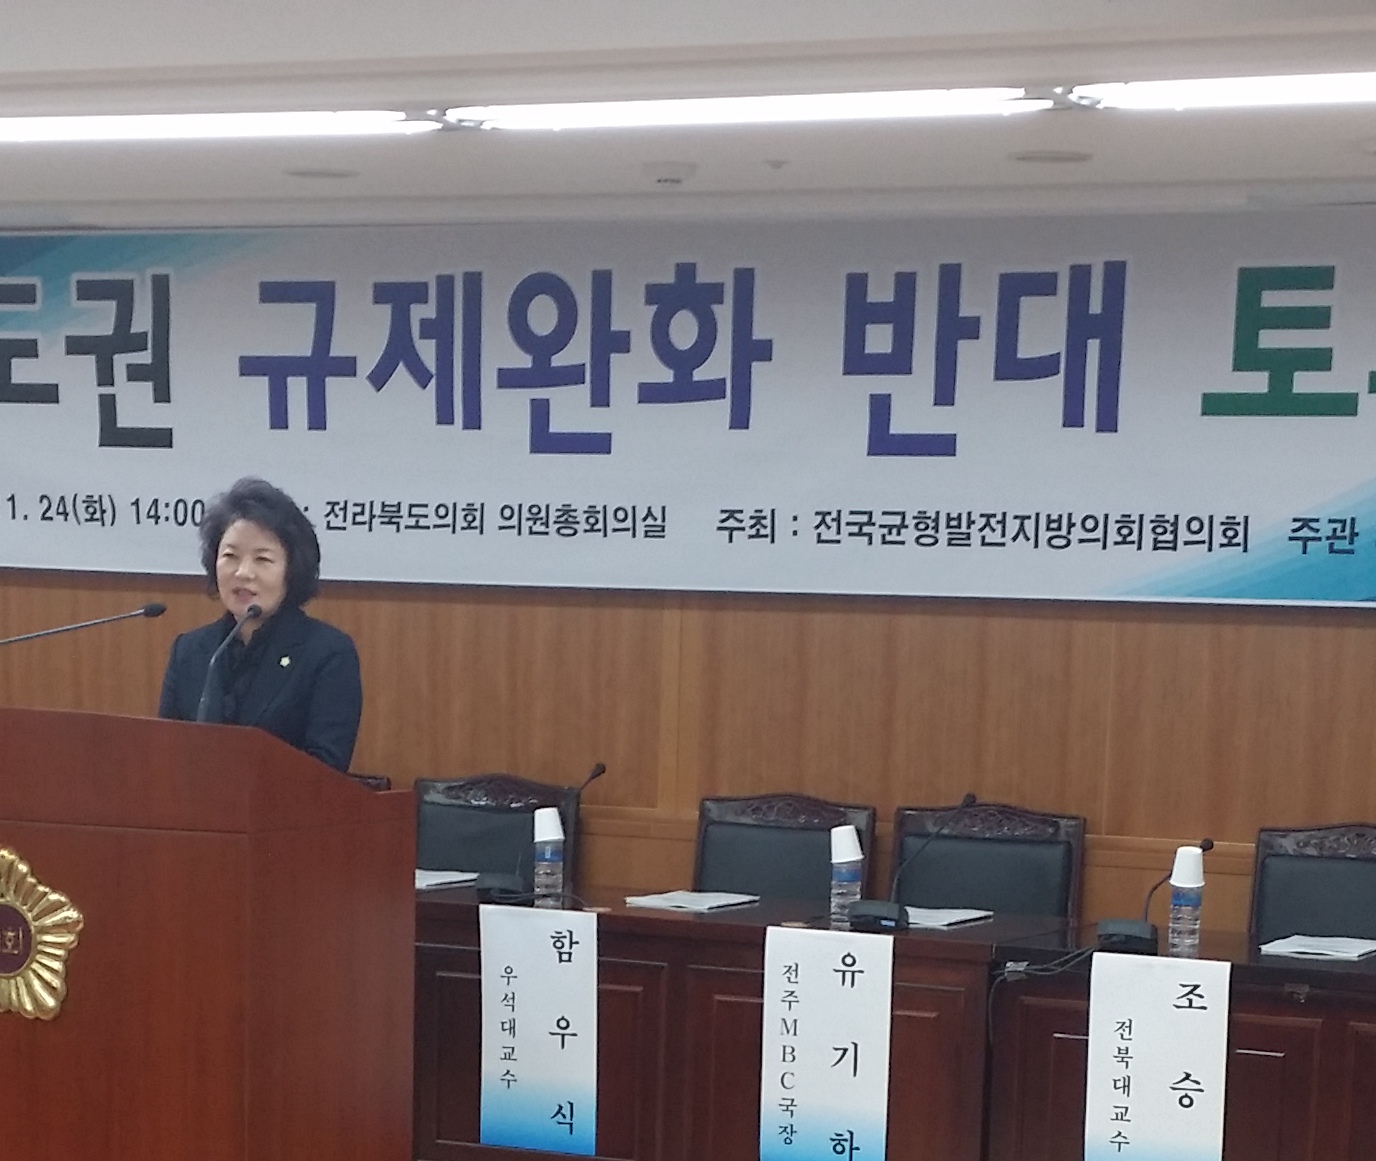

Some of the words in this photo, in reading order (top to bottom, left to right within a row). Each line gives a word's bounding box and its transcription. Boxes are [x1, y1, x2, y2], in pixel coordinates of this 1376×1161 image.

[238, 262, 773, 455] 규제완화
[842, 260, 1128, 457] 반대
[39, 493, 117, 527] 24(화)
[130, 498, 206, 527] 14:00
[323, 500, 486, 535] 전라북도의회
[497, 502, 668, 539] 의원총회의실
[715, 507, 777, 544] 주최
[812, 508, 1251, 553] 전국균형발전지방의회협의회
[1287, 515, 1359, 555] 주관
[499, 965, 519, 1090] 우석대교수
[549, 929, 580, 1136] 함우식
[778, 962, 801, 1146] 전주MBC국장
[1109, 1018, 1134, 1153] 전북대교수
